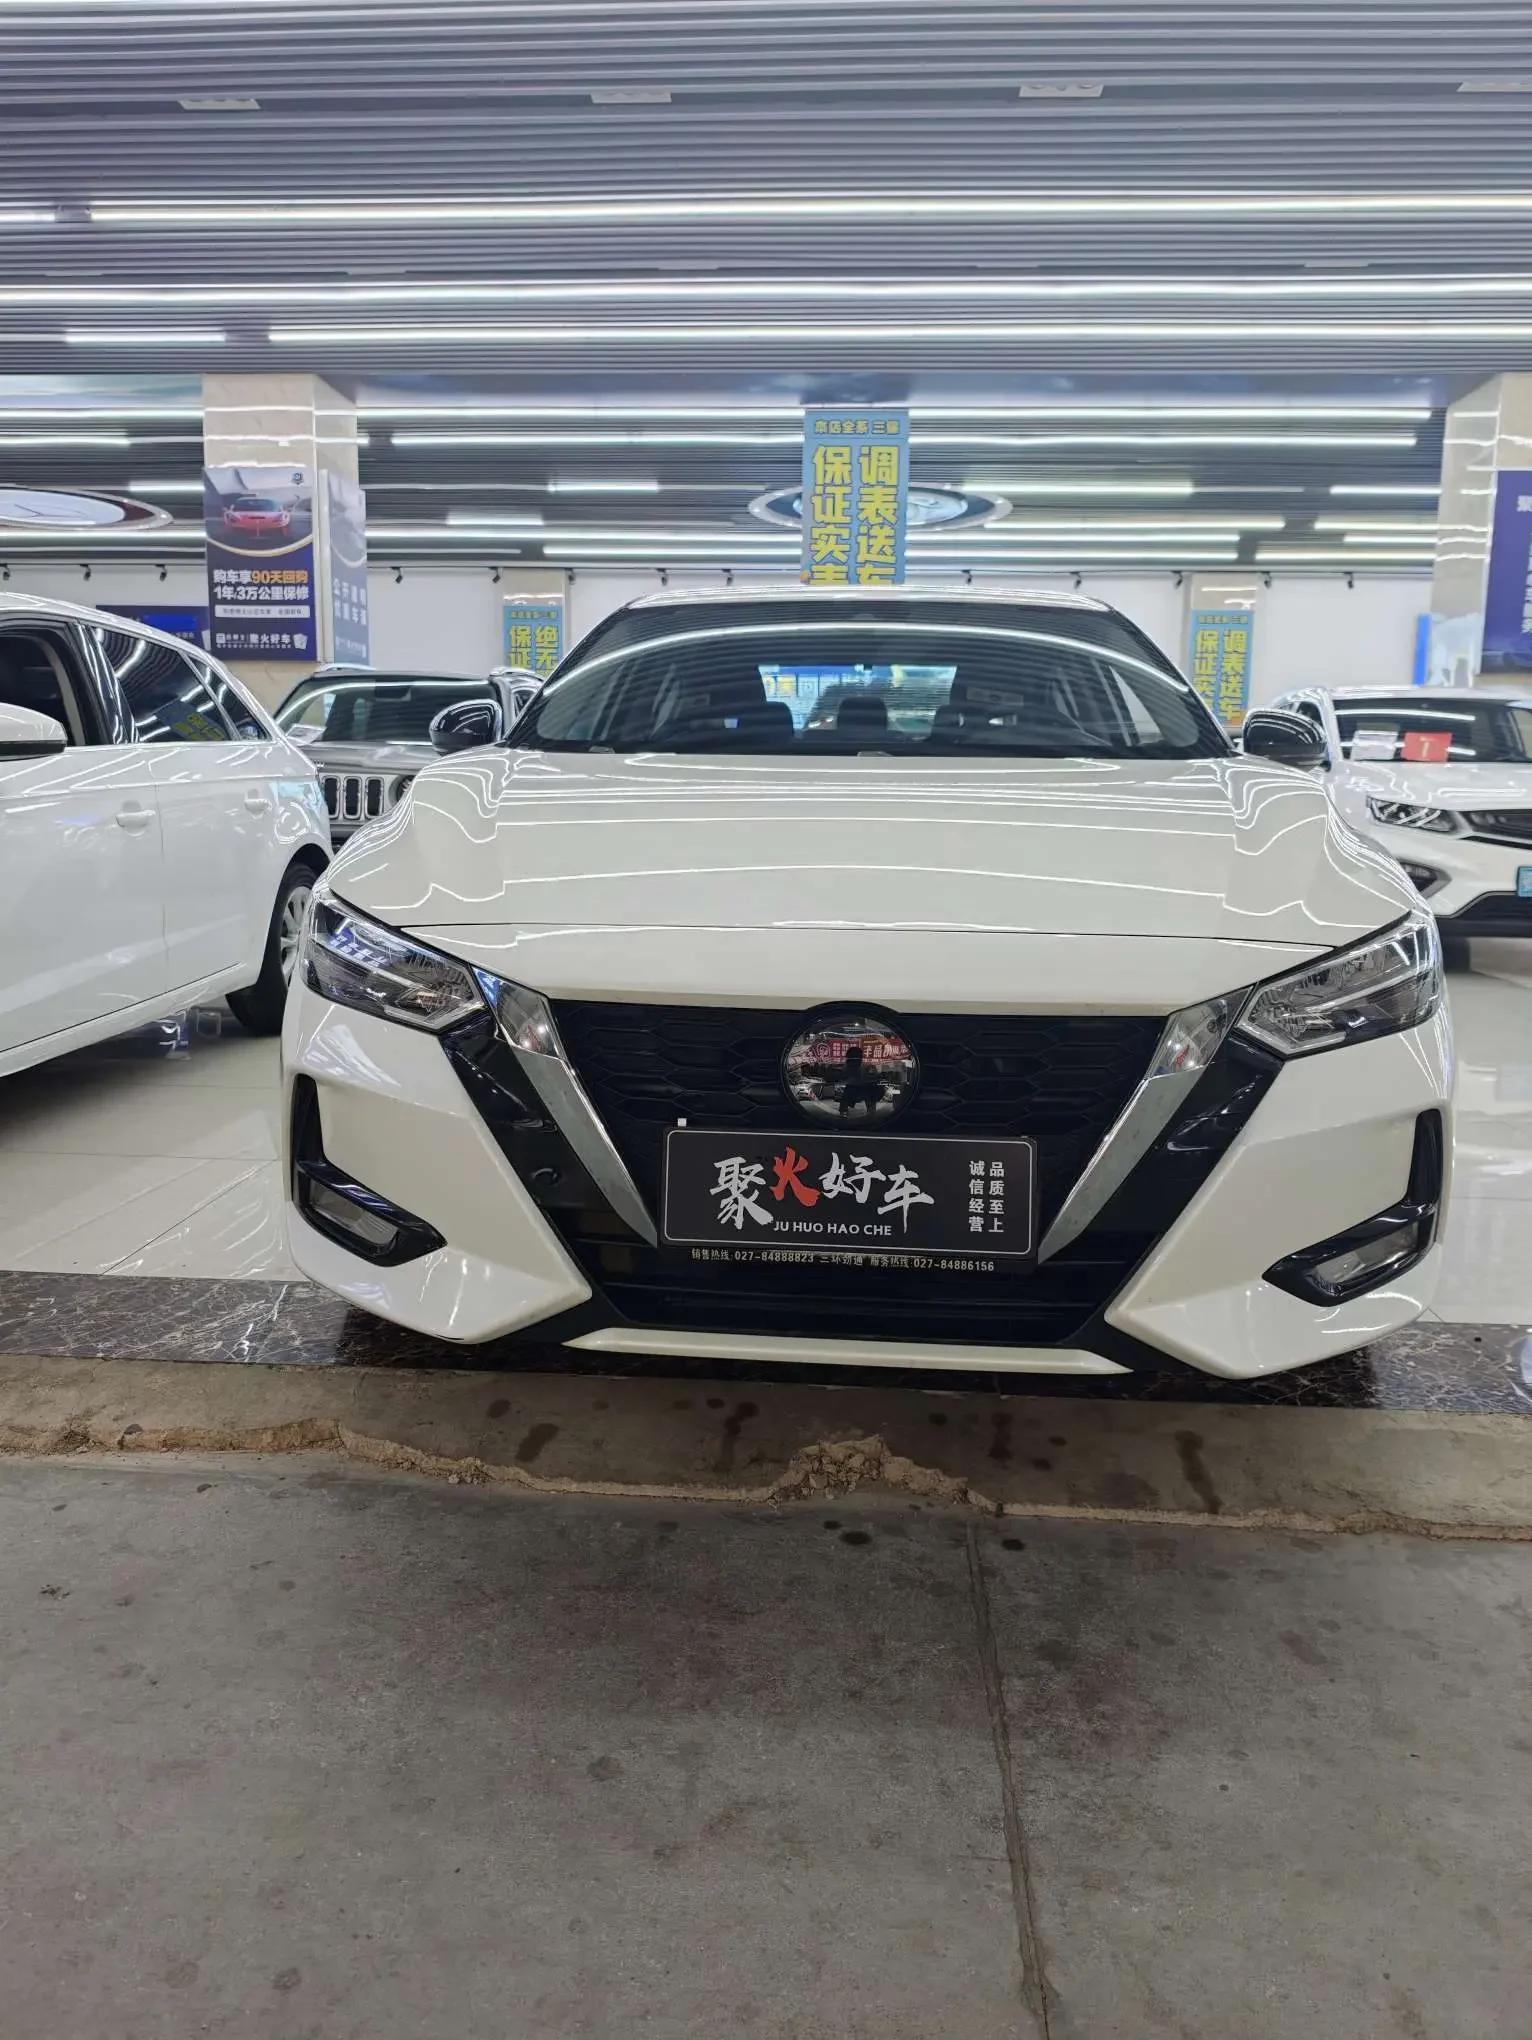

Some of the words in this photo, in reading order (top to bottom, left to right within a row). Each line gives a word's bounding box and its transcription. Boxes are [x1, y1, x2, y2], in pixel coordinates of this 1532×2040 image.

[710, 1146, 934, 1233] 聚火好车
[968, 1160, 985, 1232] 诚信经营
[988, 1161, 1005, 1233] 品质至上
[773, 1221, 789, 1232] JU
[793, 1222, 824, 1233] HUO
[827, 1223, 860, 1234] HAO
[863, 1225, 892, 1236] CHE
